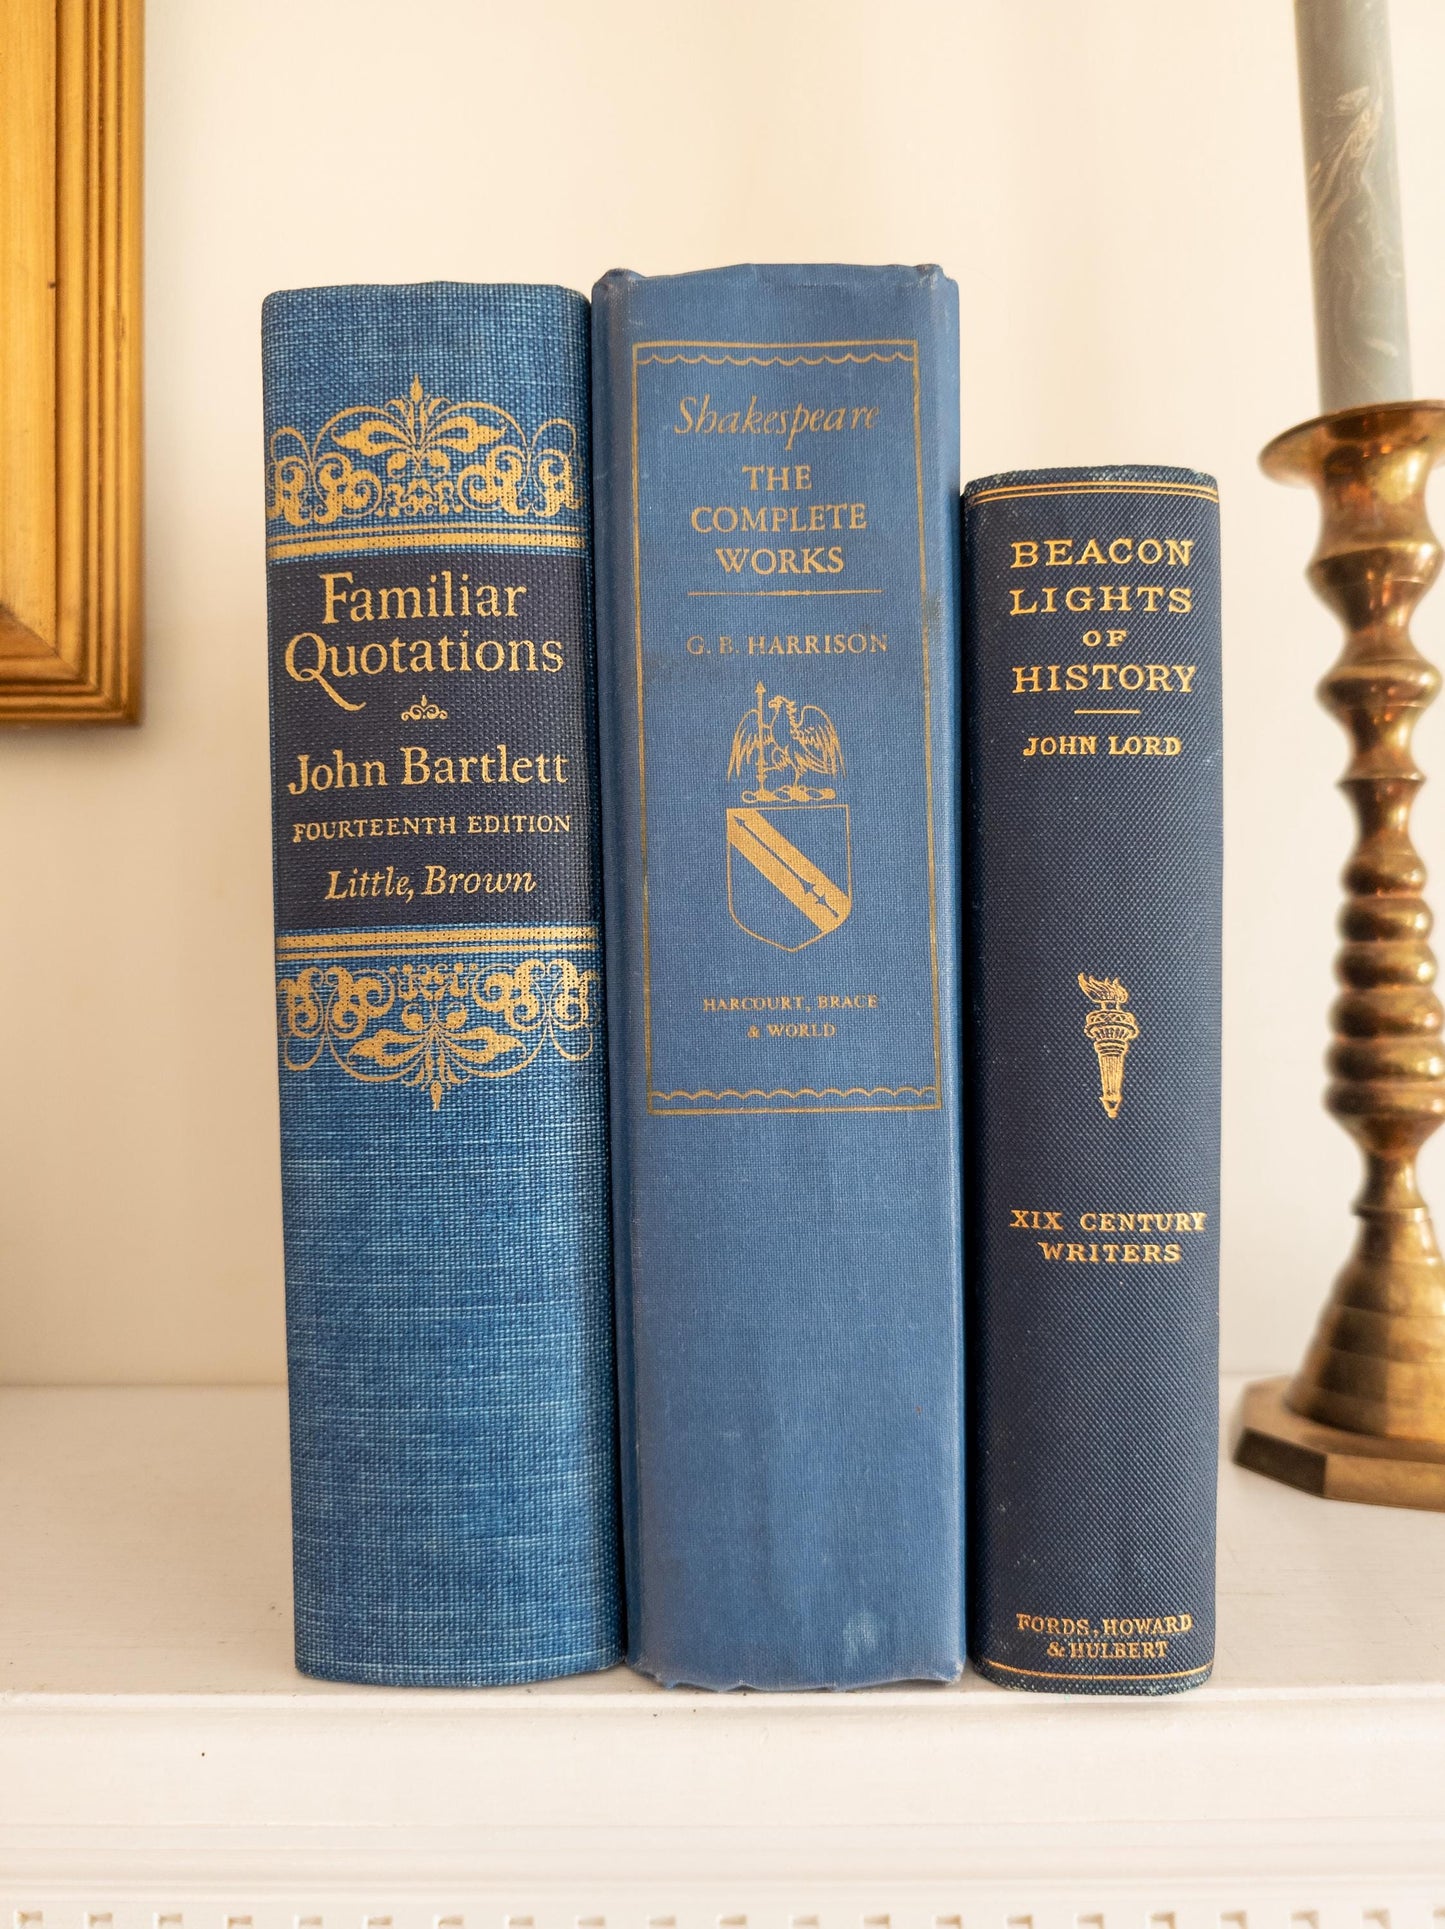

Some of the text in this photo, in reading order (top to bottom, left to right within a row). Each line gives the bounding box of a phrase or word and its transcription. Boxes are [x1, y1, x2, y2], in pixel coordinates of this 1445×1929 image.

[674, 394, 880, 451] Shakespeare
[741, 465, 812, 491] THE
[691, 503, 867, 533] COMPLETE
[715, 547, 844, 575] WORKS
[1010, 538, 1194, 569] BEACON
[320, 571, 527, 624] Familiar
[1010, 586, 1193, 616] LIGHTS
[686, 635, 711, 654] G.
[748, 633, 888, 655] HARRISON
[1082, 629, 1128, 647] OF
[284, 630, 564, 711] Quotations
[1011, 663, 1196, 694] HISTORY
[1023, 736, 1182, 756] JOHN LORD
[287, 744, 569, 795] John Bartlett
[292, 814, 572, 843] FOURTEENTH EDITION
[324, 865, 537, 903] Little, Brown
[703, 994, 879, 1012] HARCOURT, BRACE
[747, 1023, 837, 1038] & WORLD
[1009, 1209, 1208, 1232] XIX CENTURY
[1037, 1241, 1182, 1263] WRITERS
[1016, 1613, 1195, 1637] FORDS, HOWARD
[1047, 1640, 1169, 1659] & HULBERT
